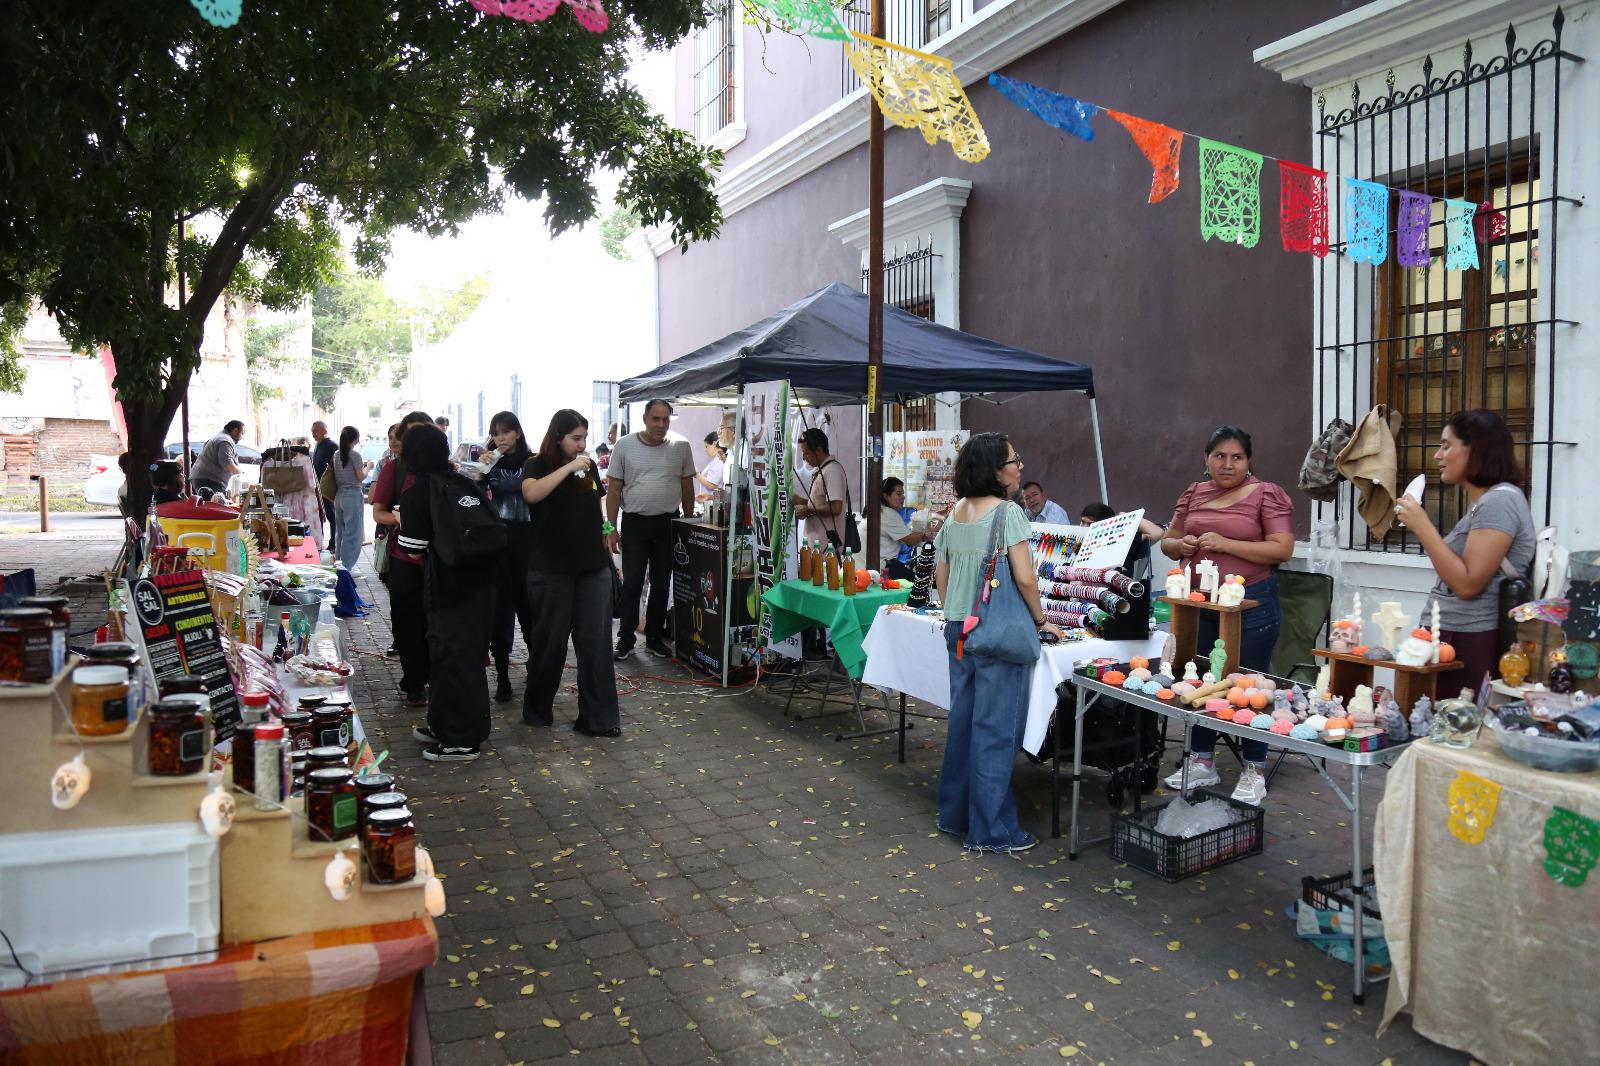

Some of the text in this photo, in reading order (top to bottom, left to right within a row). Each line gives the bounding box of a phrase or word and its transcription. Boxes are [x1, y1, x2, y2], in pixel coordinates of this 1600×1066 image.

[773, 392, 785, 486] ARTESANAL
[137, 591, 154, 602] SAL
[167, 591, 206, 606] ARTESANALES
[143, 600, 160, 612] SAL
[175, 613, 214, 631] CONDIMENTOS
[692, 606, 703, 632] 10
[208, 683, 234, 699] CONTACTO
